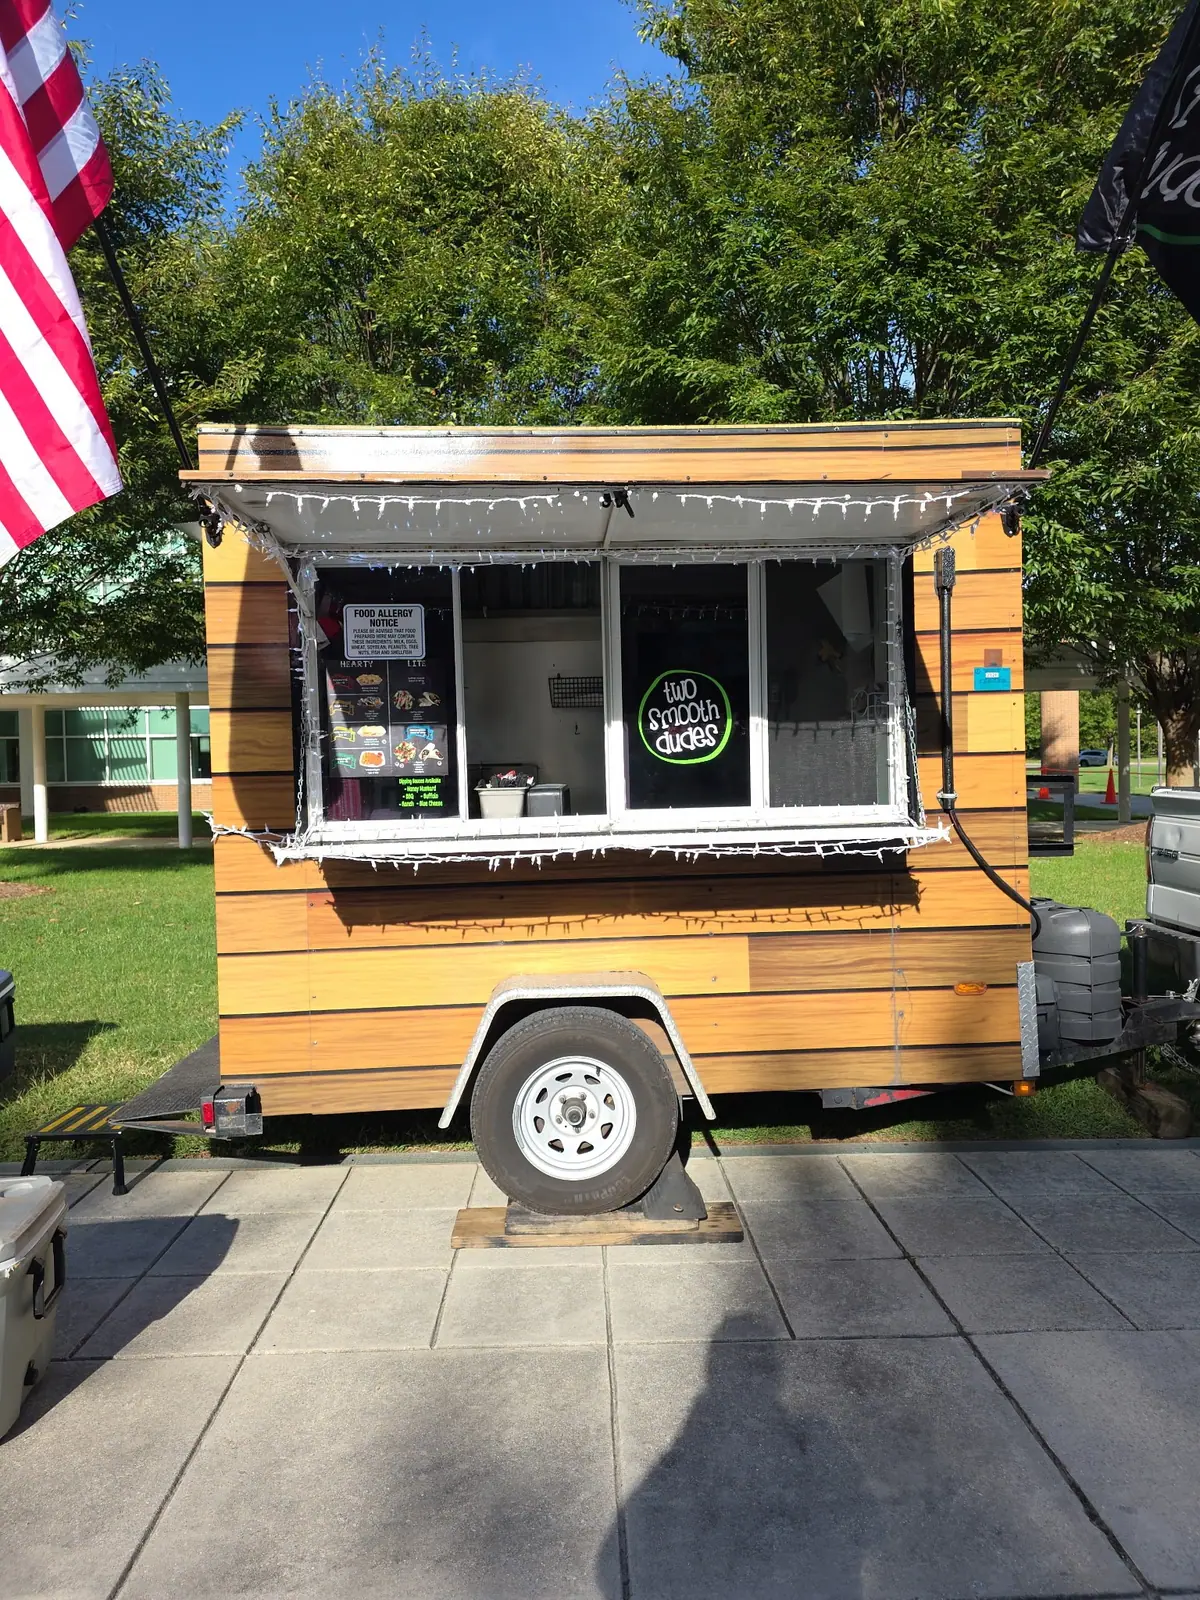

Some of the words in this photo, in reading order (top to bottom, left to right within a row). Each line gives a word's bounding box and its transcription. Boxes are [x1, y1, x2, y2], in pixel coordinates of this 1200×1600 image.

[354, 609, 375, 618] FOOD
[378, 609, 413, 618] ALLERGY
[370, 619, 399, 627] NOTICE
[663, 679, 697, 703] two
[648, 700, 720, 730] smooth
[656, 724, 718, 754] dudes
